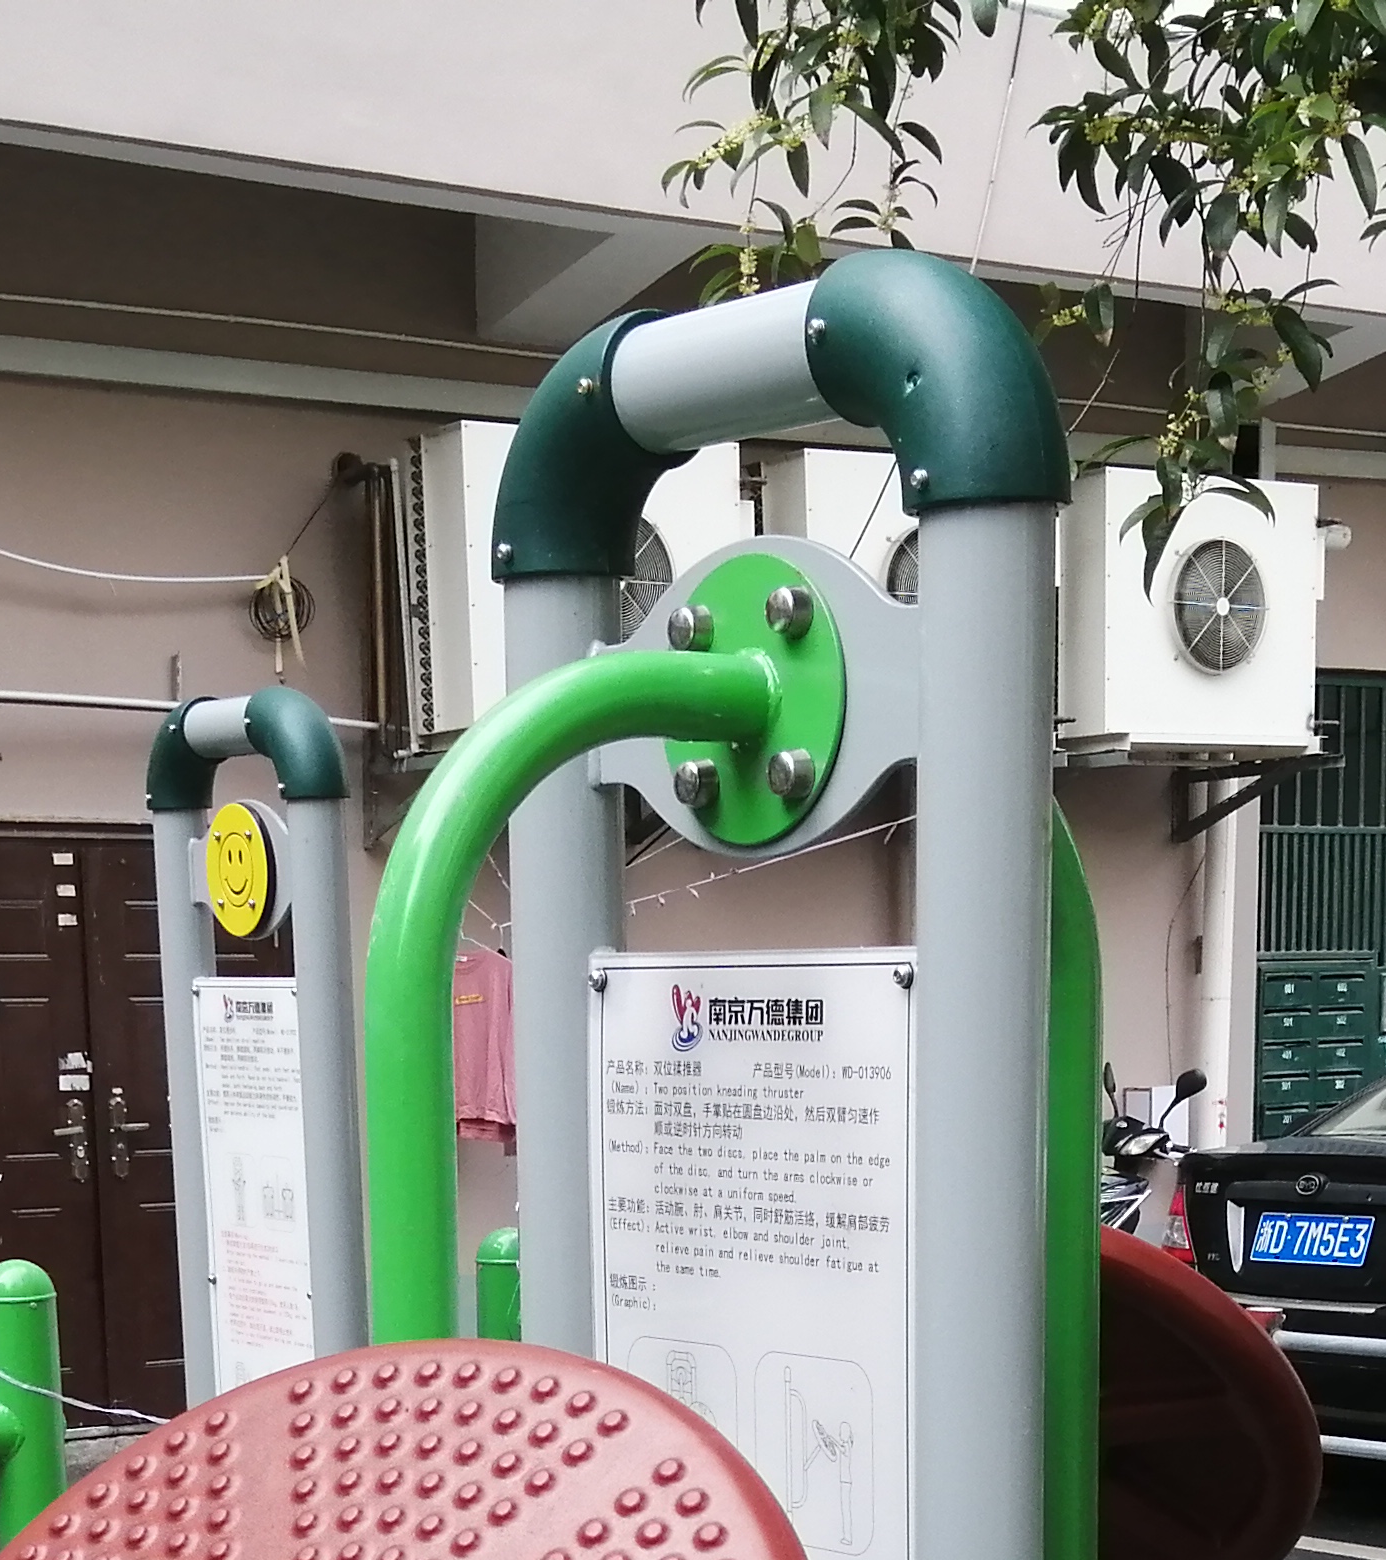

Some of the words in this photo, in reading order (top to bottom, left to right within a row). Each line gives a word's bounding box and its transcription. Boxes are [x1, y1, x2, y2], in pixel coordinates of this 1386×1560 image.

[708, 997, 824, 1026] 南京万德集团
[708, 1029, 824, 1043] NANJINGWANDEGROUP
[653, 1082, 669, 1095] Two
[672, 1083, 713, 1098] position
[717, 1084, 758, 1099] kneading
[763, 1086, 804, 1099] thruster
[654, 1121, 743, 1140] 顺或逆时针方向转动
[653, 1142, 674, 1155] Face
[678, 1143, 693, 1156] the
[698, 1145, 713, 1157] two
[752, 1147, 779, 1162] place
[784, 1149, 799, 1162] the
[804, 1150, 826, 1164] palm
[830, 1153, 842, 1164] on
[847, 1151, 863, 1165] the
[868, 1154, 891, 1169] edge
[654, 1162, 664, 1174] of
[669, 1164, 684, 1175] the
[718, 1167, 733, 1179] and
[737, 1169, 758, 1180] turn
[763, 1168, 779, 1181] the
[783, 1172, 805, 1183] arms
[809, 1170, 858, 1186] clockwise
[863, 1176, 874, 1187] or
[654, 1183, 699, 1197] clockwise
[703, 1186, 713, 1198] at
[718, 1189, 723, 1198] a
[727, 1187, 764, 1201] uniform
[655, 1220, 684, 1235] Active
[723, 1228, 749, 1241] elbow
[753, 1229, 769, 1242] and
[773, 1231, 815, 1246] shoulder
[655, 1242, 689, 1255] relieve
[693, 1245, 714, 1259] pain
[718, 1247, 734, 1259] and
[739, 1249, 774, 1263] relieve
[779, 1252, 820, 1267] shoulder
[826, 1255, 863, 1273] fatigue
[868, 1261, 880, 1273] at
[656, 1261, 671, 1273] the
[675, 1266, 695, 1276] same
